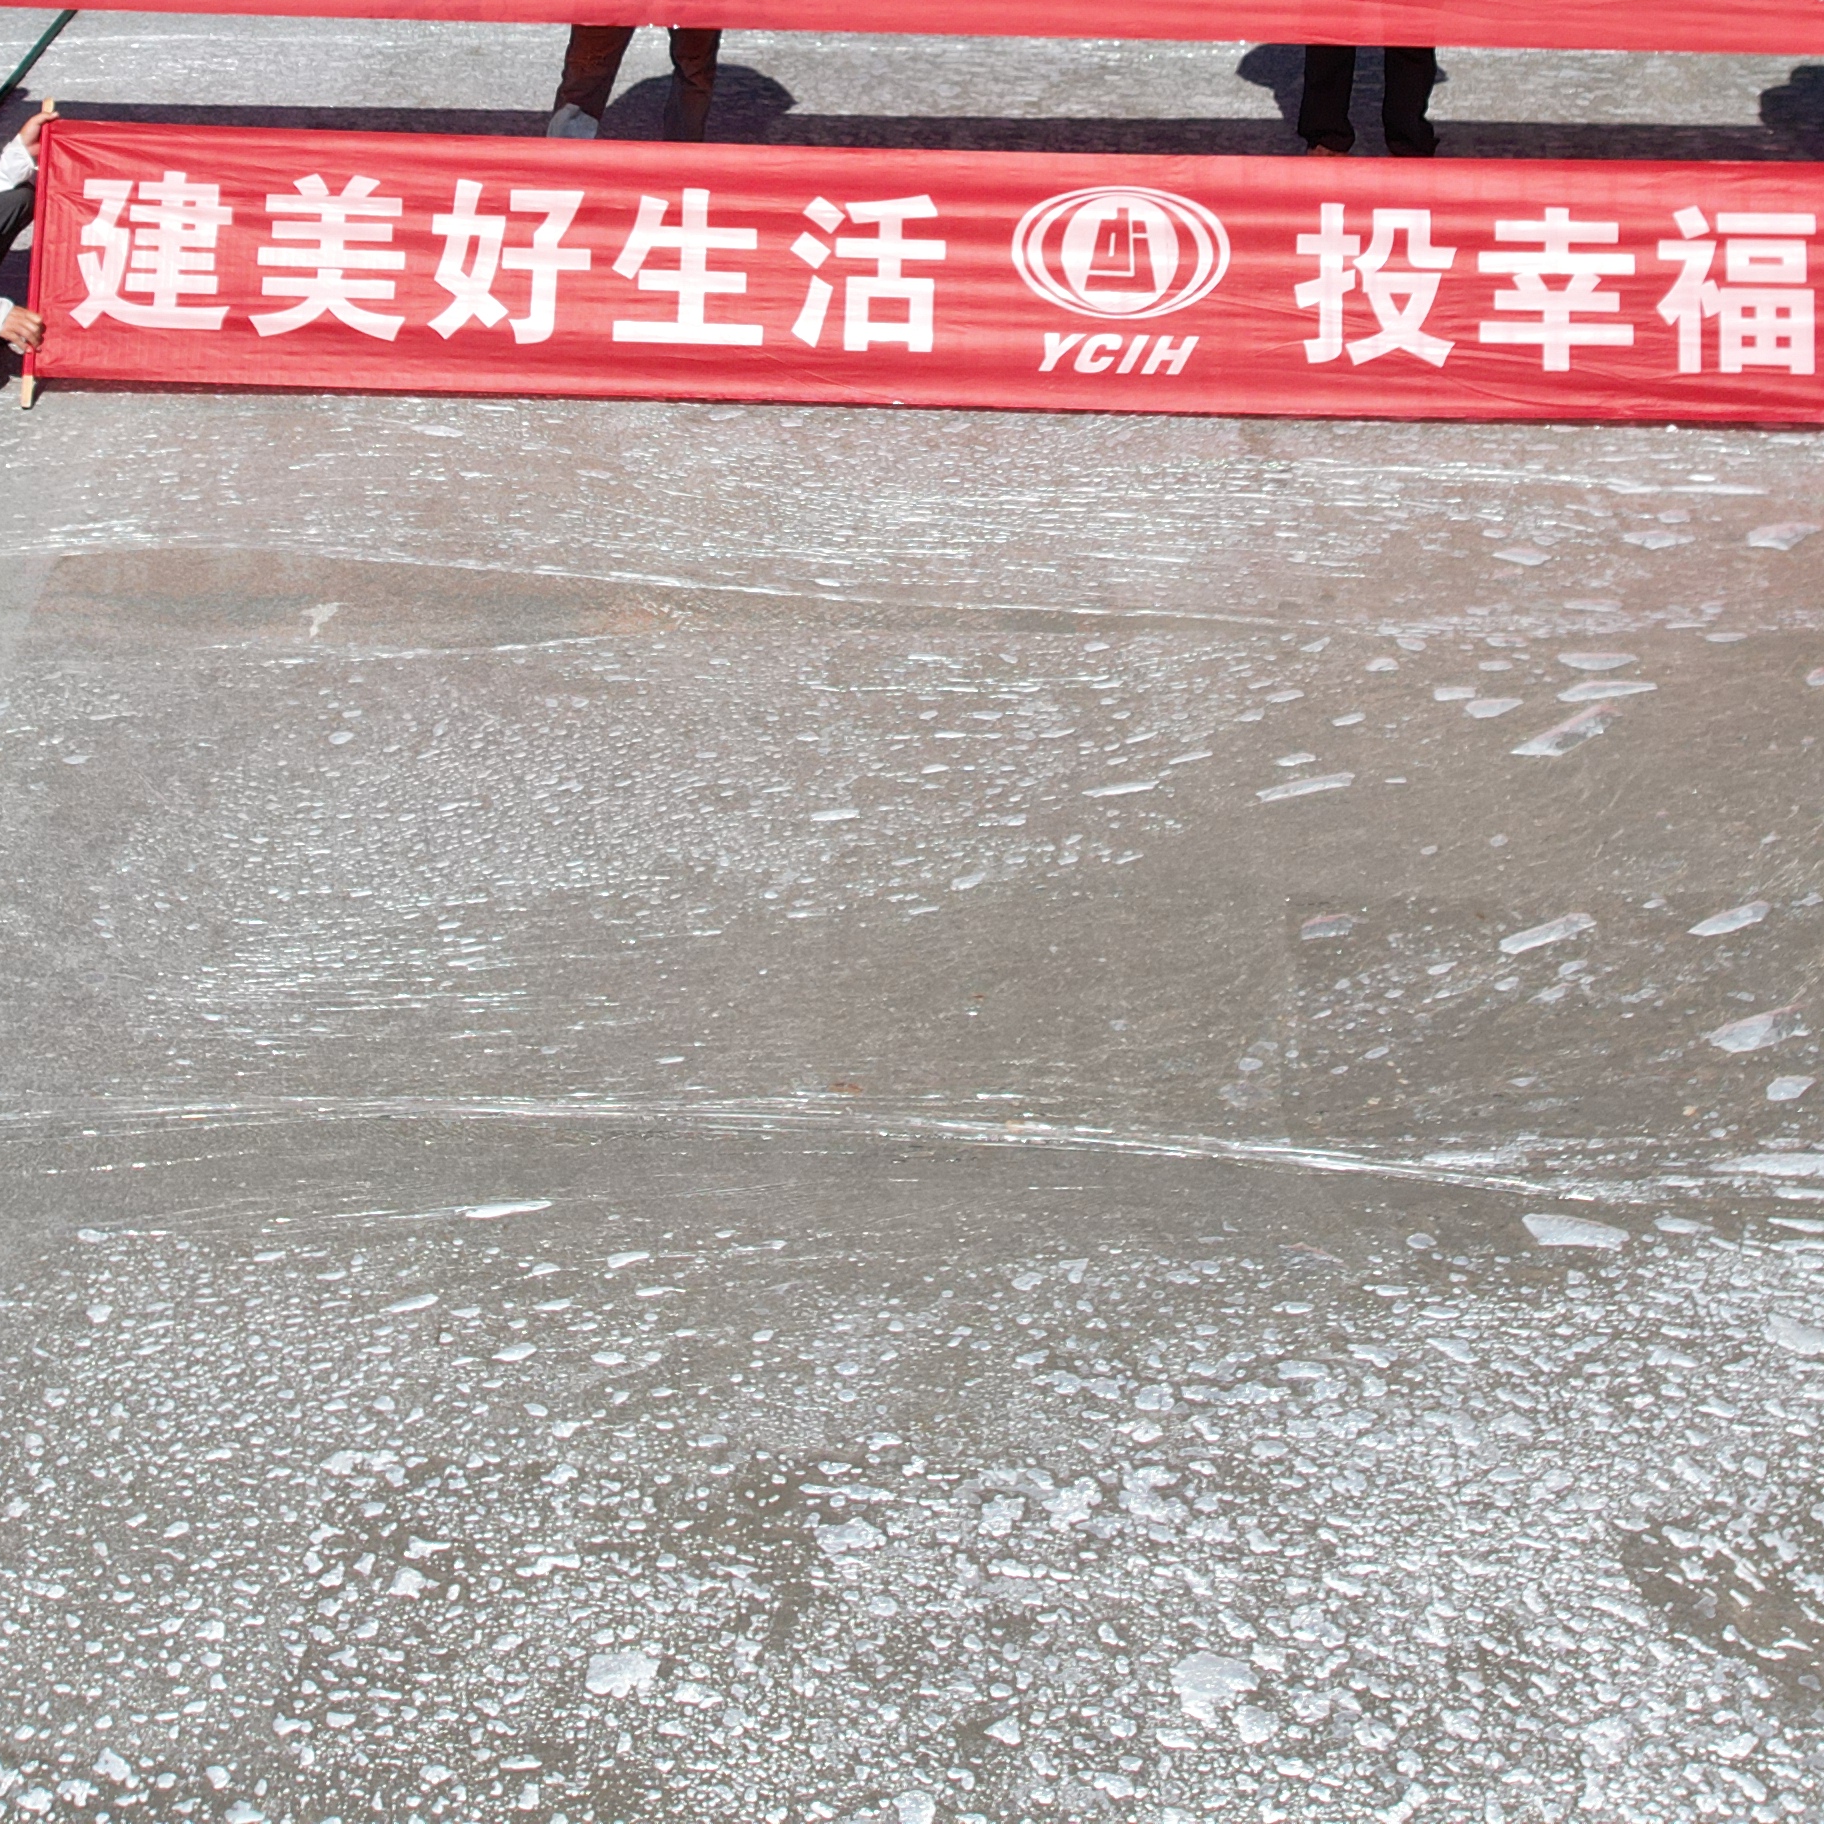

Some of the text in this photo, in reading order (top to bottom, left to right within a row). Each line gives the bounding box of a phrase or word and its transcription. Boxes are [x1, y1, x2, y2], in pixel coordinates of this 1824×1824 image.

[70, 171, 947, 353] 建美好生活
[1038, 332, 1200, 375] YCIH
